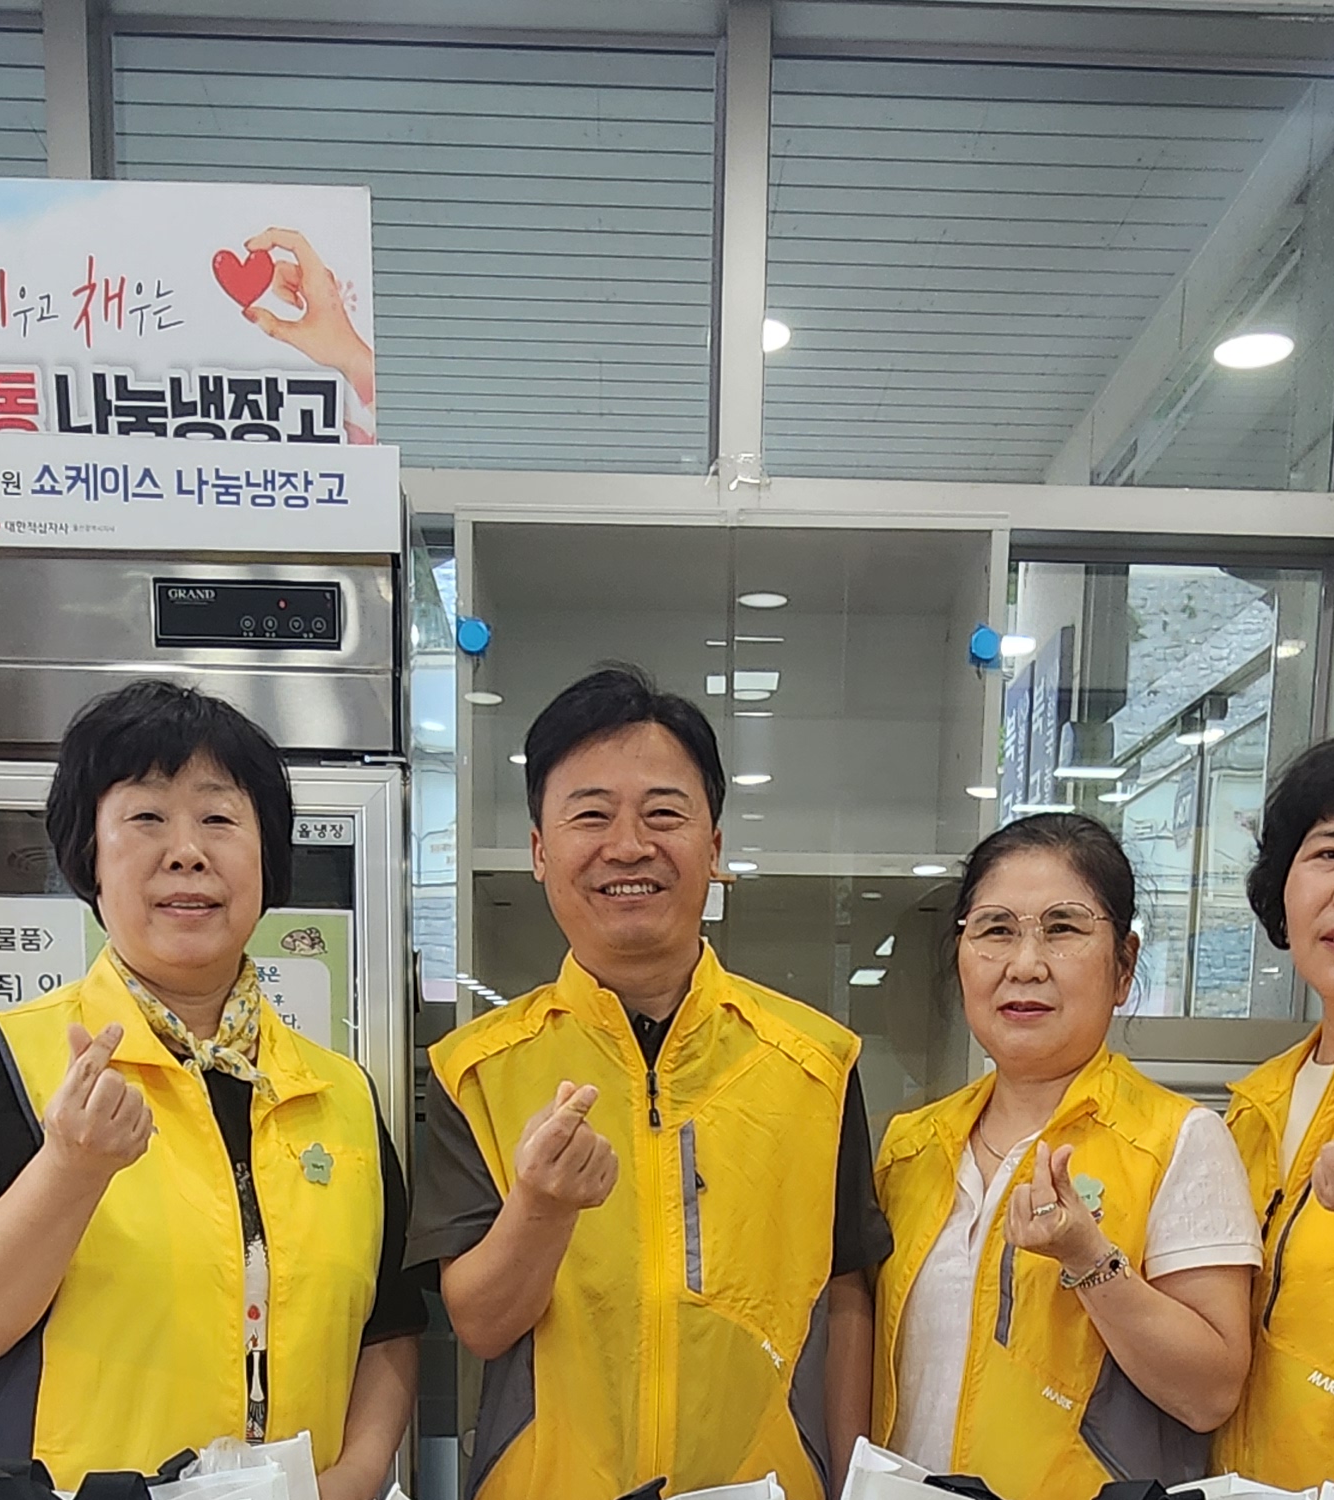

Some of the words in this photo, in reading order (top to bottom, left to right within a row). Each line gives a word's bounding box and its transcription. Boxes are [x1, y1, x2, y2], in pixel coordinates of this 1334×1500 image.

[72, 254, 186, 349] 채우는
[54, 371, 342, 445] 나눔냉장고
[30, 462, 164, 502] 쇼케이스
[174, 467, 349, 508] 나눔냉장고
[4, 520, 68, 535] 대한적십자사
[167, 588, 216, 600] GRAND
[1041, 1385, 1073, 1410] MARK
